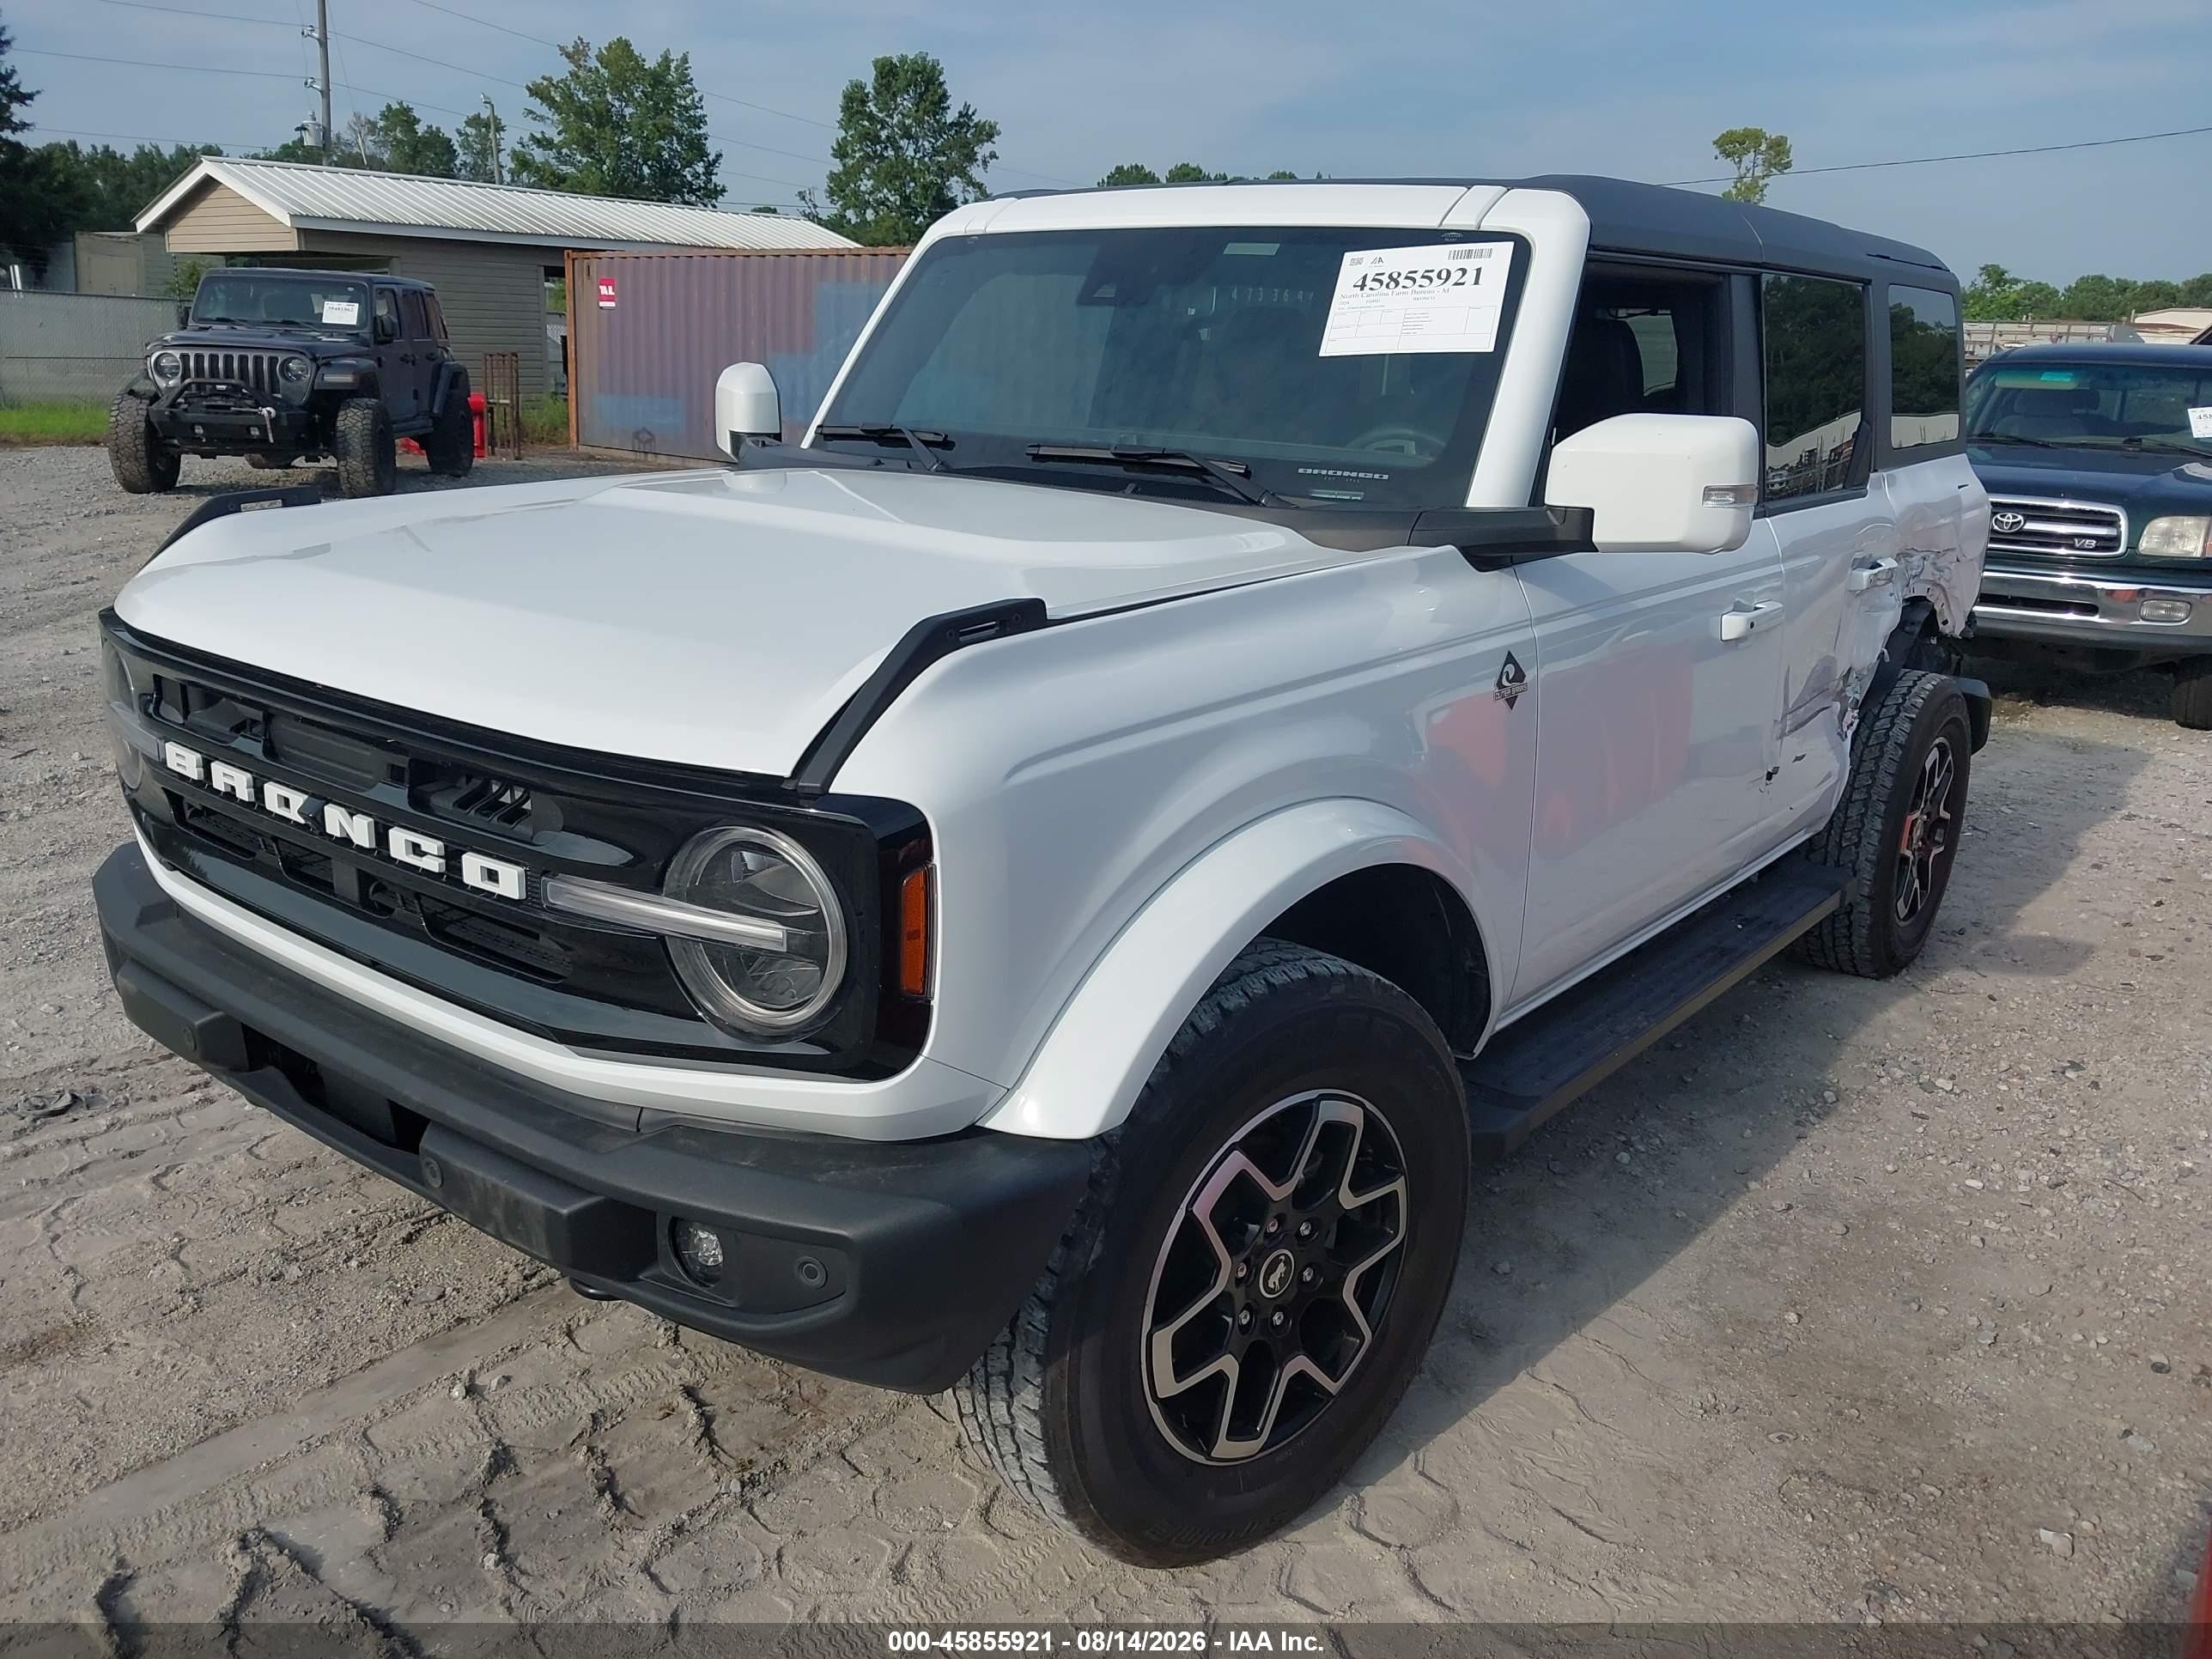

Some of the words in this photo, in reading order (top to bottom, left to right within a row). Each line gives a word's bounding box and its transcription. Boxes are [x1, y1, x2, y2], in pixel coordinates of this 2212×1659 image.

[1352, 266, 1483, 291] 45855921
[1297, 468, 1389, 480] BRONCO
[2074, 538, 2096, 549] V8
[165, 741, 527, 900] BRONCO
